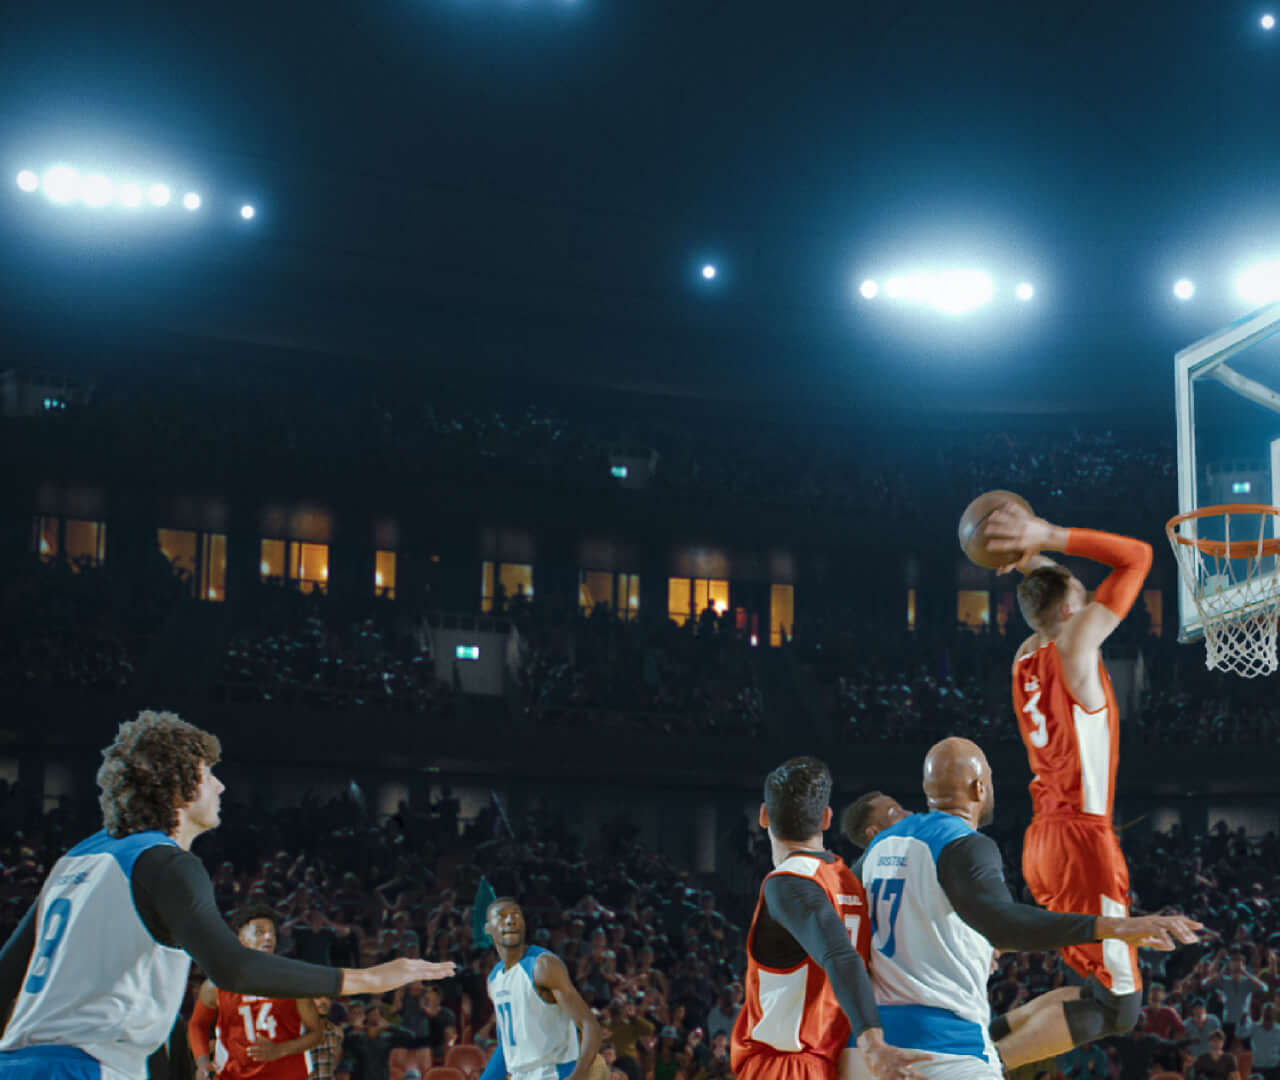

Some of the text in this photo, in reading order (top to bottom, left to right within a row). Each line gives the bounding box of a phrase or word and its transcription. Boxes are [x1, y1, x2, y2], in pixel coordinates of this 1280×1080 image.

[1022, 691, 1049, 748] 3
[871, 878, 906, 959] 17
[238, 1002, 278, 1043] 14
